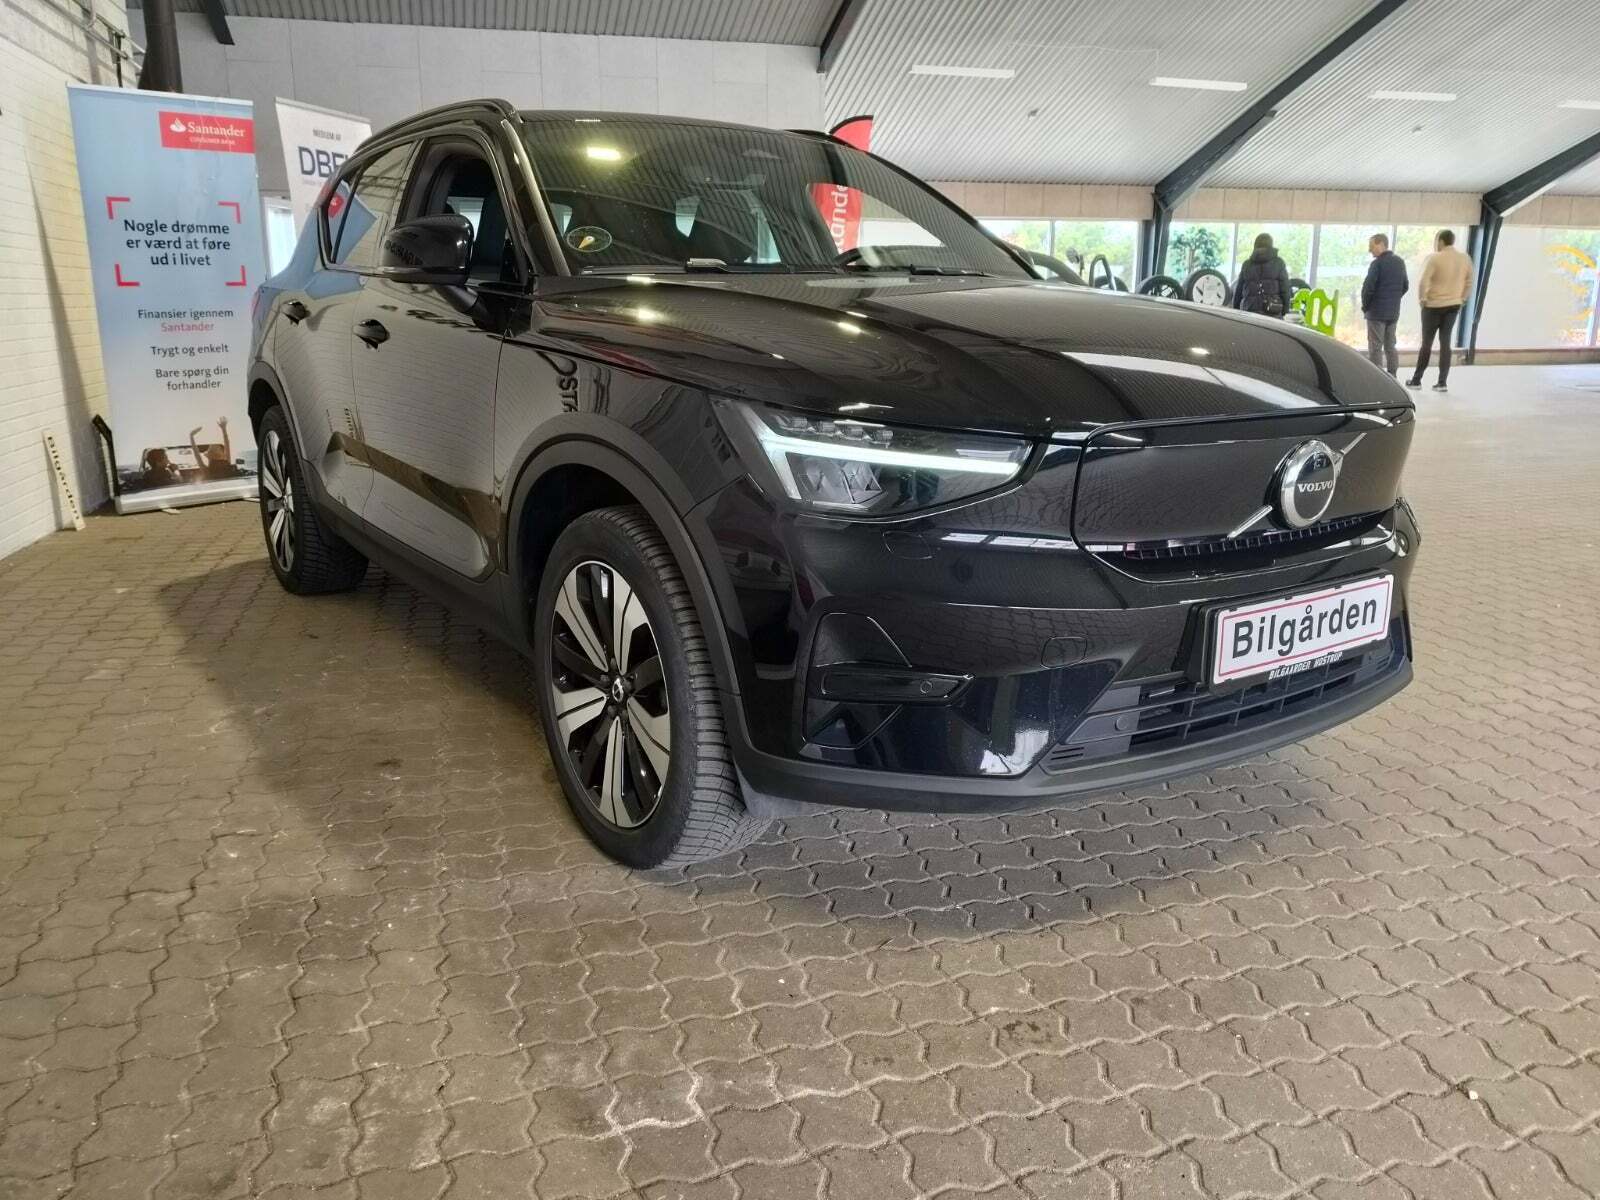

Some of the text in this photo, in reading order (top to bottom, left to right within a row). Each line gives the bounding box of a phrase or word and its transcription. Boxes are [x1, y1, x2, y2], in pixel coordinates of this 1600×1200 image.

[187, 121, 246, 137] Santander
[123, 219, 230, 236] Nogle drømme
[126, 236, 231, 250] er værd at føre
[150, 253, 212, 266] ud i livet
[137, 308, 234, 321] Finansier igennem
[161, 321, 214, 332] Santander
[151, 343, 229, 358] Trygt og enkelt
[155, 365, 229, 378] Bare spørg din
[167, 380, 221, 391] forhandler
[1297, 480, 1333, 493] VOLVO
[1232, 598, 1377, 658] Bilgården
